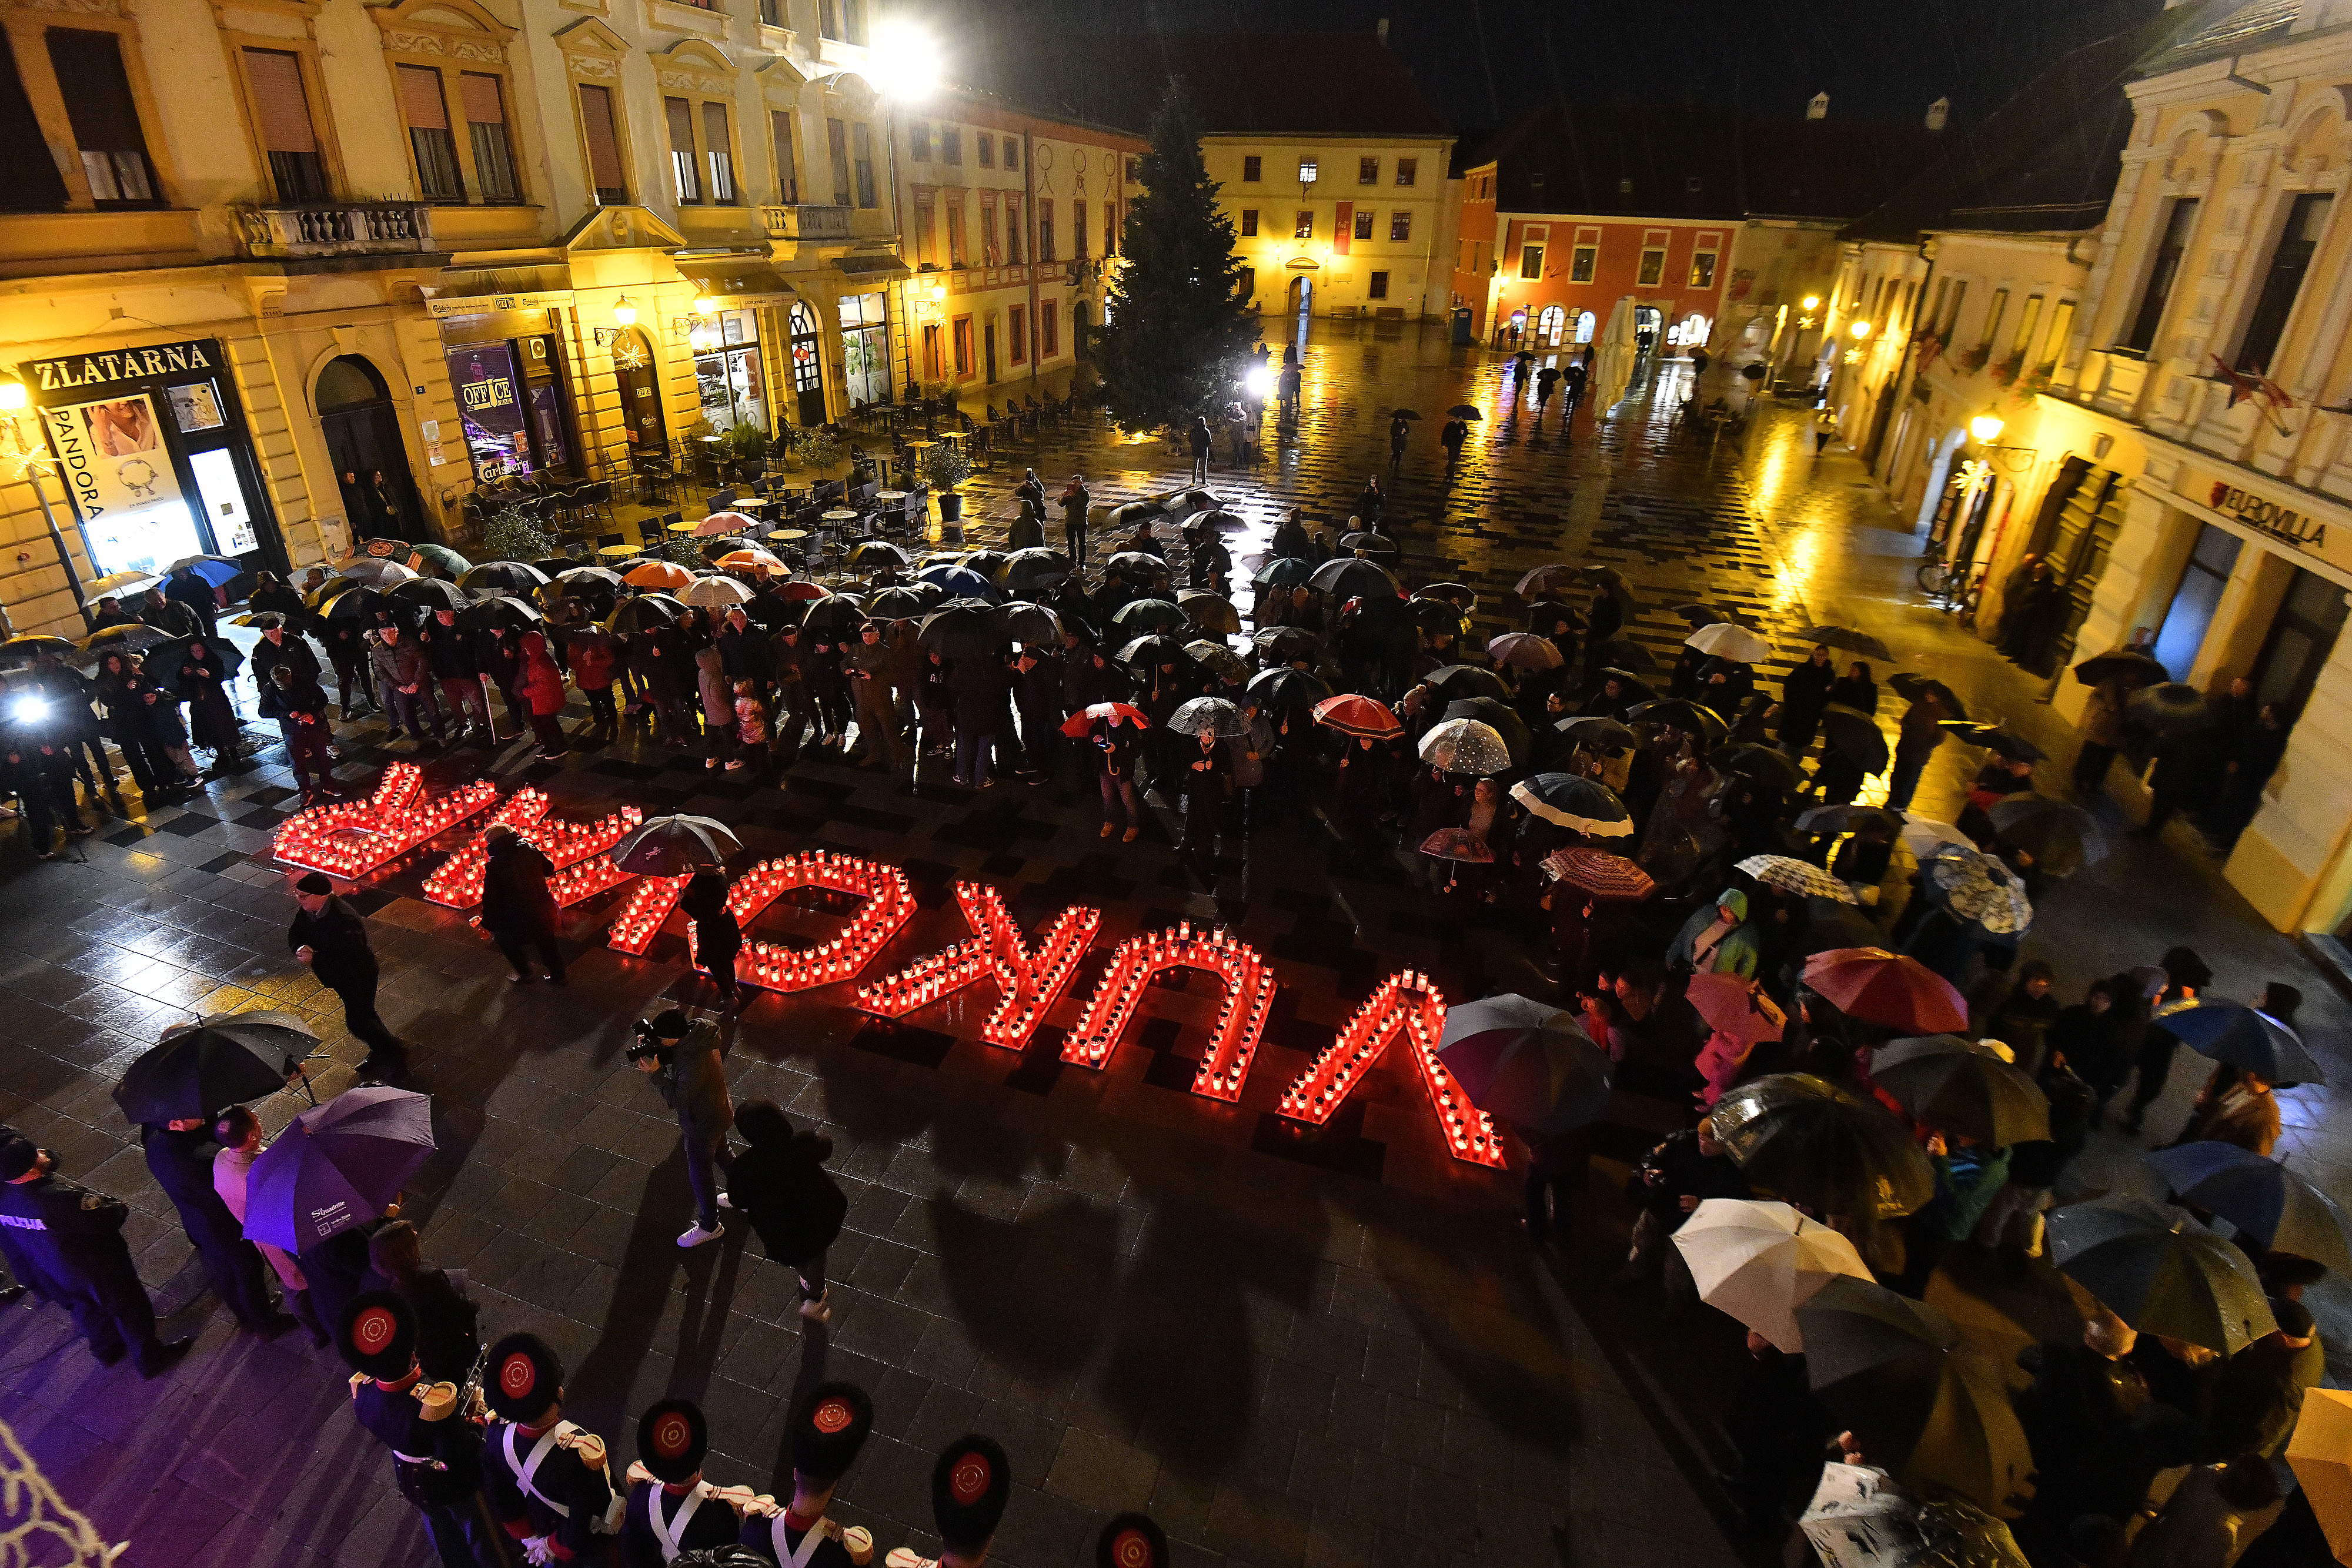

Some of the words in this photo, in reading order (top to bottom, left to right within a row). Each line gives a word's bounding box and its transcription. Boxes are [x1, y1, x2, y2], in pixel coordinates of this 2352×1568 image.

[34, 344, 210, 390] ZLATARNA
[463, 380, 512, 407] OFFICE
[52, 410, 104, 520] PANDORA
[479, 460, 530, 484] Carlsberg
[272, 760, 1508, 1171] VUKOVAR
